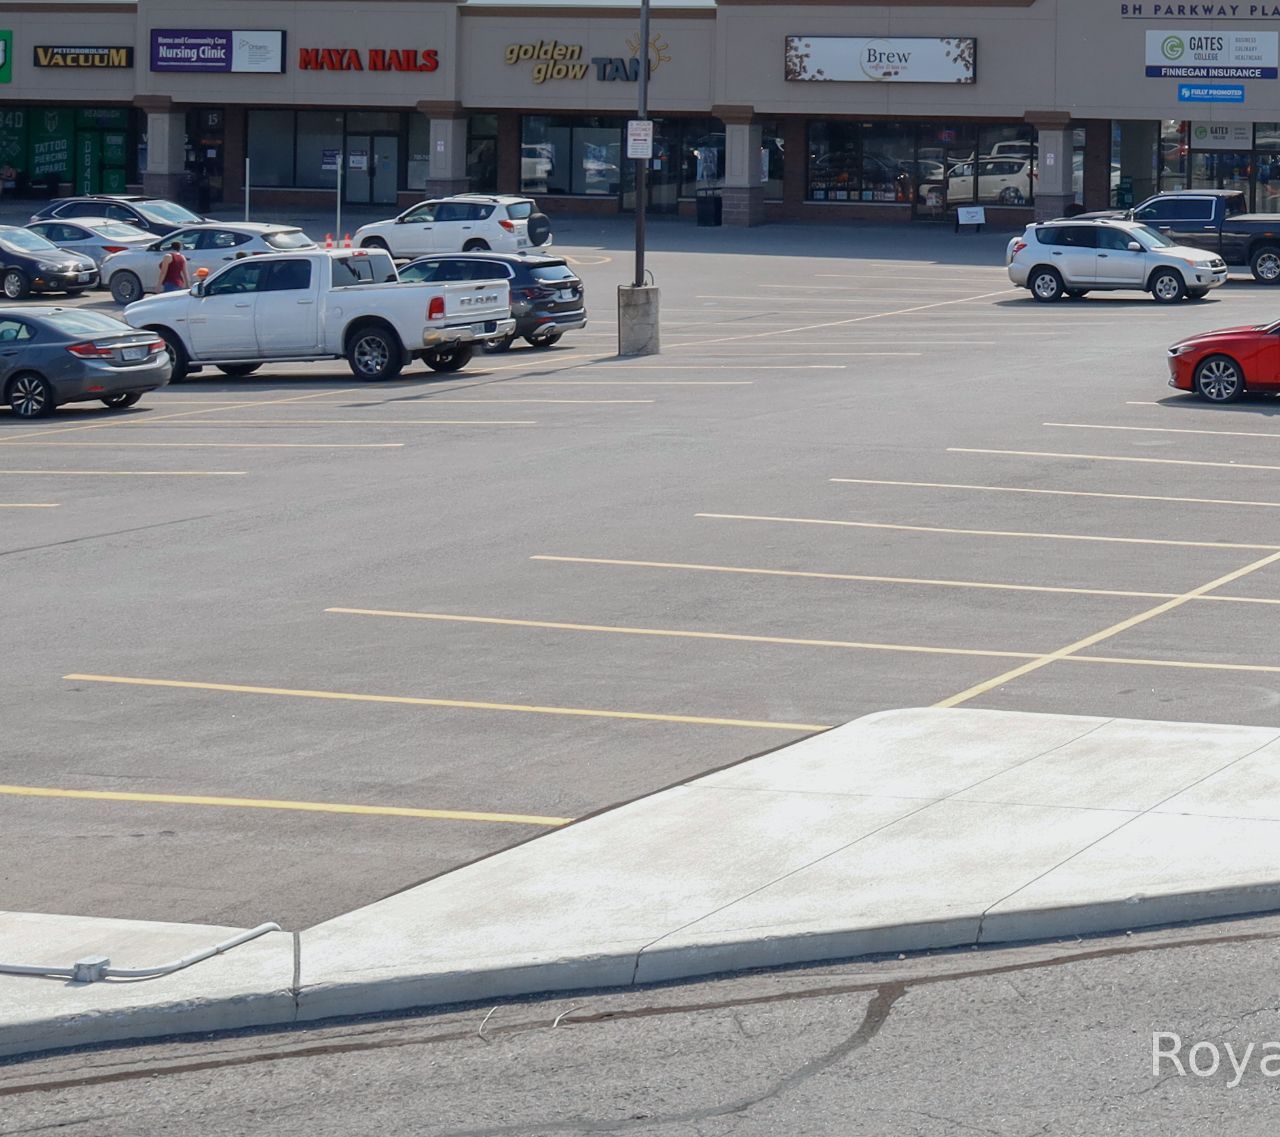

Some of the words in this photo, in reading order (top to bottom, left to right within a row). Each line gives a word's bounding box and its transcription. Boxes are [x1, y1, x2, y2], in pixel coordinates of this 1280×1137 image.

[1121, 4, 1142, 15] BH
[1154, 4, 1239, 16] PARKWAY
[185, 37, 214, 46] Community
[1189, 37, 1223, 51] GATES
[37, 48, 127, 66] VACUUM
[159, 46, 197, 61] Nursing
[199, 46, 226, 59] Clinic
[505, 40, 582, 64] golden
[867, 48, 912, 63] Brew
[1194, 53, 1219, 61] COLLEGE
[299, 48, 363, 71] MAYA
[369, 49, 439, 72] NAILS
[533, 59, 589, 84] glow
[591, 57, 650, 81] TAN
[1162, 68, 1207, 77] FINNEGAN
[1209, 68, 1262, 78] INSURANCE
[208, 114, 218, 125] 15
[1210, 126, 1229, 135] GATES
[34, 139, 67, 154] TATTOO
[34, 151, 67, 164] PIERCING
[460, 294, 498, 305] RAM
